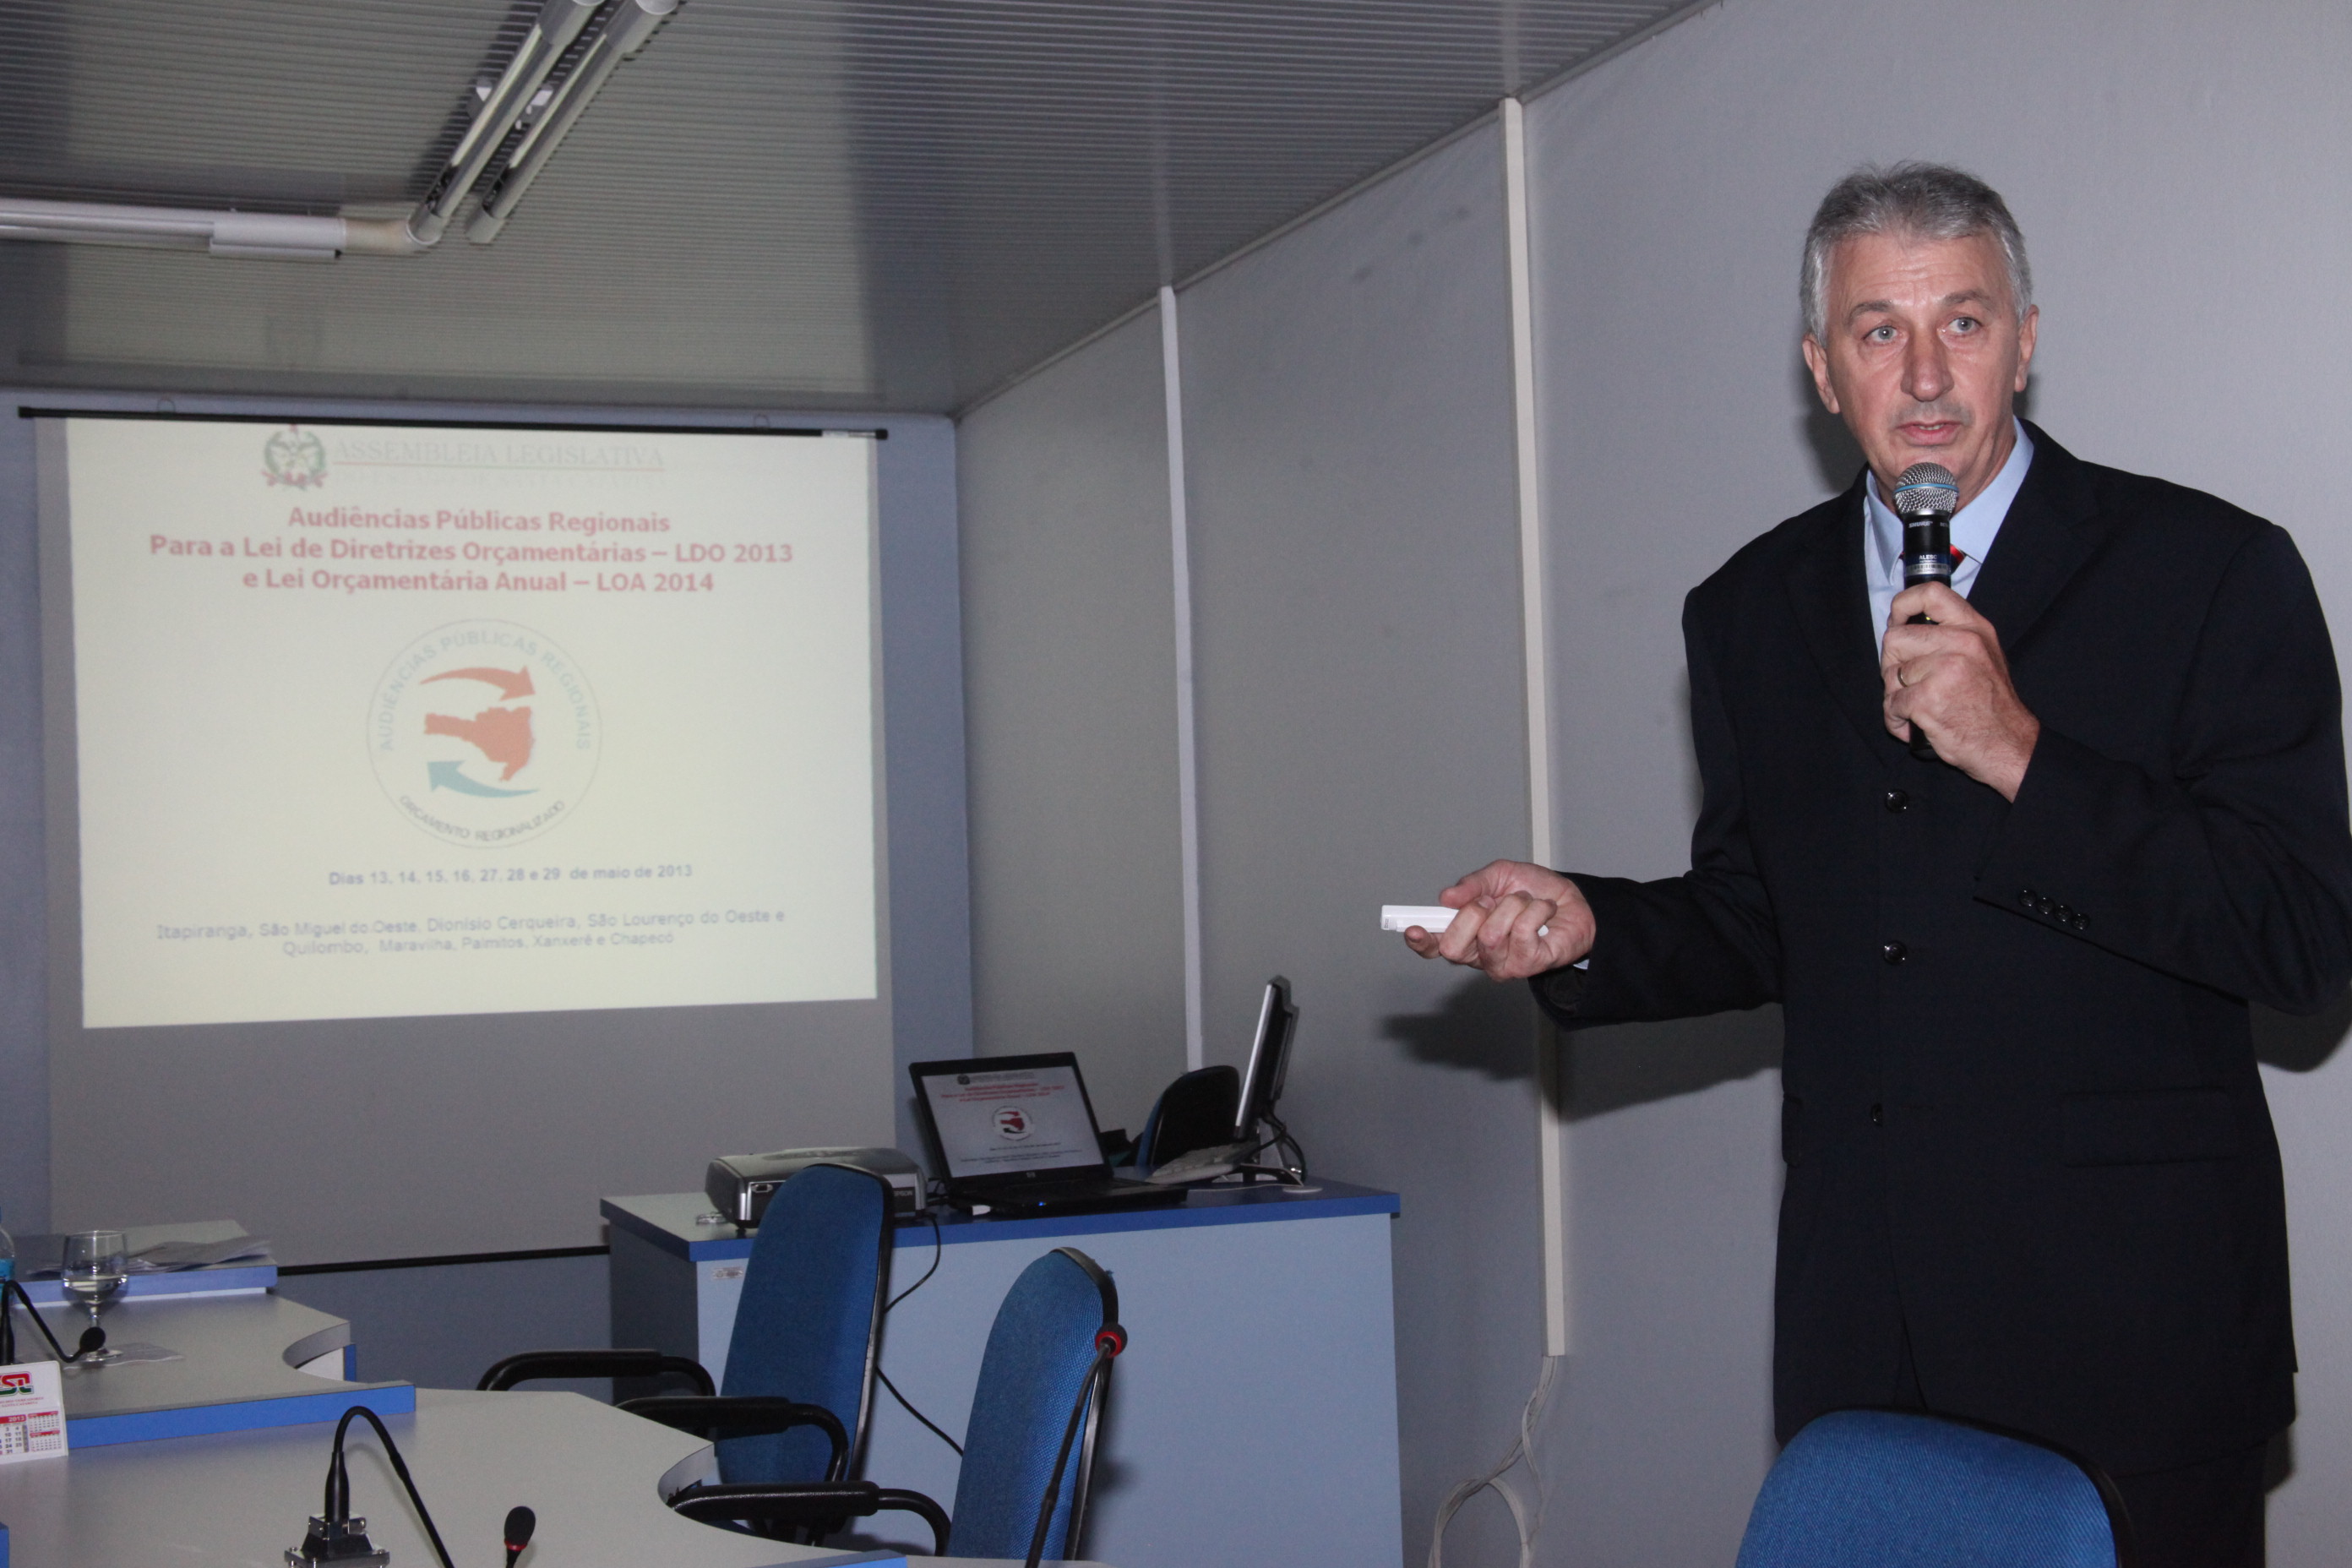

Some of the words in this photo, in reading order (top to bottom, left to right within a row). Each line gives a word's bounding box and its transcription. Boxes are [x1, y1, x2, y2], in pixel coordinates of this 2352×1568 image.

[335, 440, 498, 463] ASSEMBLEIA
[506, 444, 664, 466] LEGISLATIVA
[288, 505, 431, 530] Audiências
[435, 508, 542, 531] Públicas
[548, 511, 671, 537] Regionais
[150, 534, 214, 556] Para
[219, 540, 236, 557] a
[242, 536, 282, 558] Lei
[291, 536, 324, 558] de
[329, 538, 457, 560] Diretrizes
[461, 540, 647, 567] Orçamentárias
[675, 542, 727, 564] LDO
[733, 542, 794, 564] 2013
[242, 572, 259, 589] e
[265, 567, 304, 589] Lei
[311, 569, 488, 595] Orçamentária
[495, 571, 567, 591] Anual
[596, 572, 647, 592] LOA
[653, 572, 715, 592] 2014
[541, 651, 591, 751] REGIONAIS
[329, 871, 365, 885] Dias
[507, 868, 525, 882] 28
[529, 870, 539, 881] e
[542, 867, 561, 881] 29
[569, 867, 589, 879] de
[593, 866, 631, 879] maio
[634, 865, 653, 879] de
[657, 864, 693, 878] 2013
[700, 910, 721, 924] do
[725, 909, 770, 924] Oeste
[775, 911, 786, 923] e
